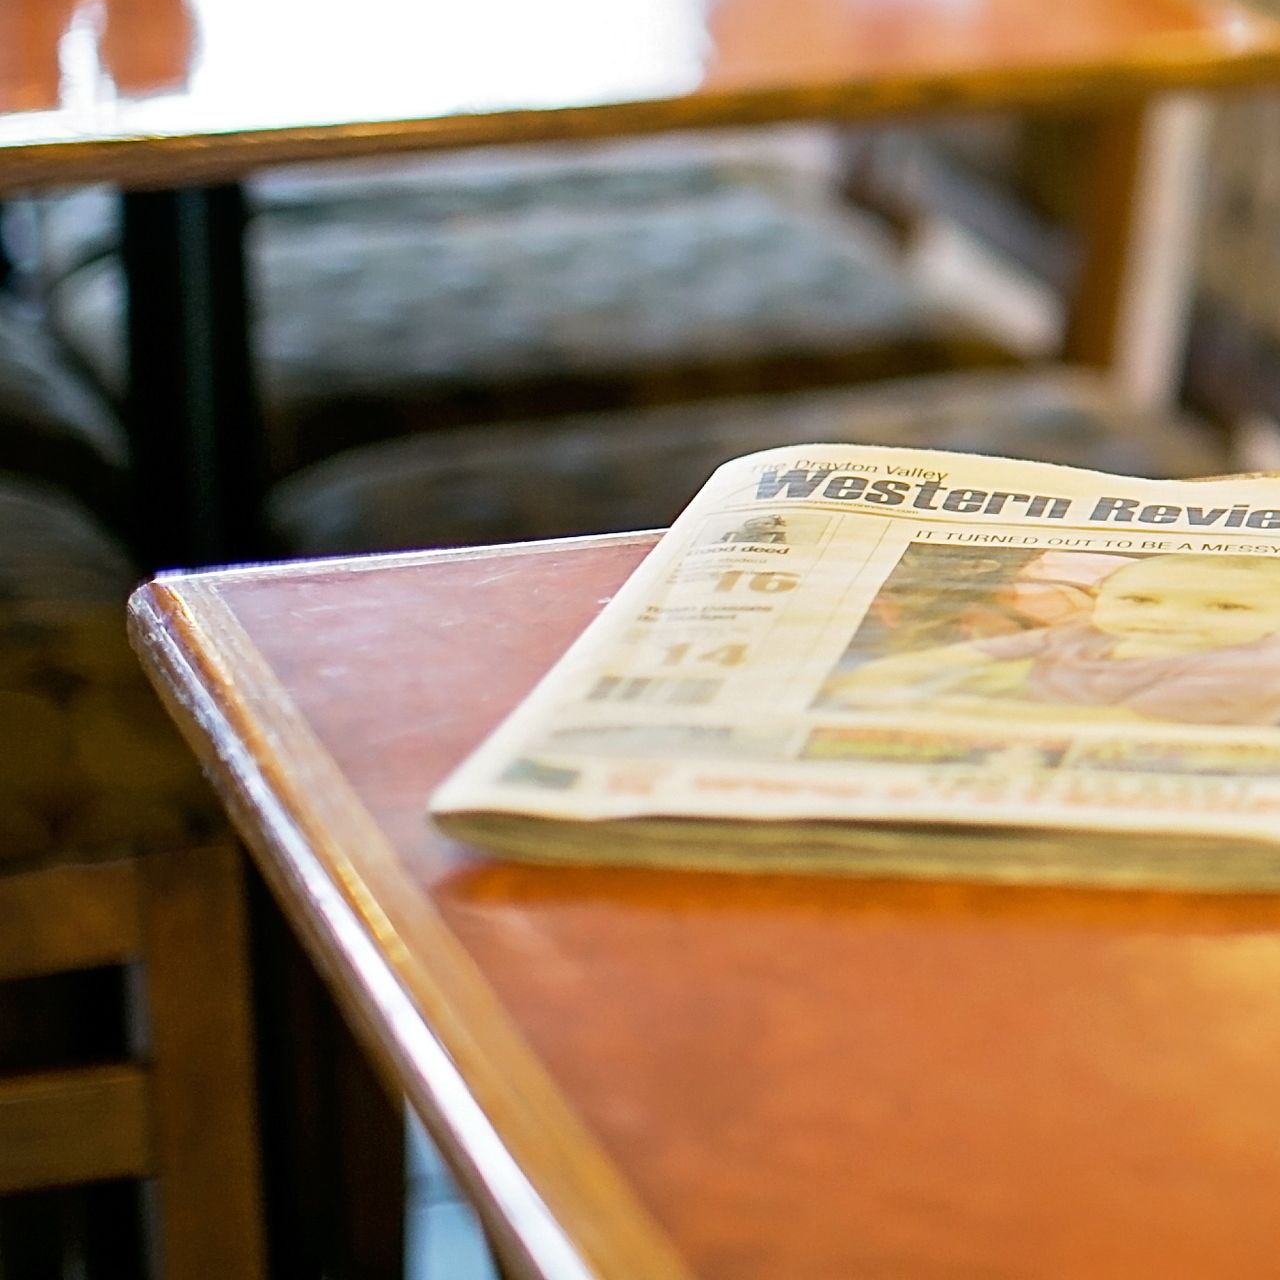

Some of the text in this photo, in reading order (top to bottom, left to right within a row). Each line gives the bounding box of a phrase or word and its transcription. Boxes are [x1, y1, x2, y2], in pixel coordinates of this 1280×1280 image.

[794, 459, 878, 473] Drayton
[885, 465, 949, 482] Valley
[755, 470, 1073, 520] Western
[740, 545, 791, 555] deed
[915, 530, 934, 539] IT
[946, 531, 1039, 546] TURNED
[1048, 536, 1092, 548] OUT
[1103, 538, 1133, 549] TO
[1140, 540, 1171, 551] BE
[1177, 542, 1194, 551] A
[714, 570, 800, 593] 16
